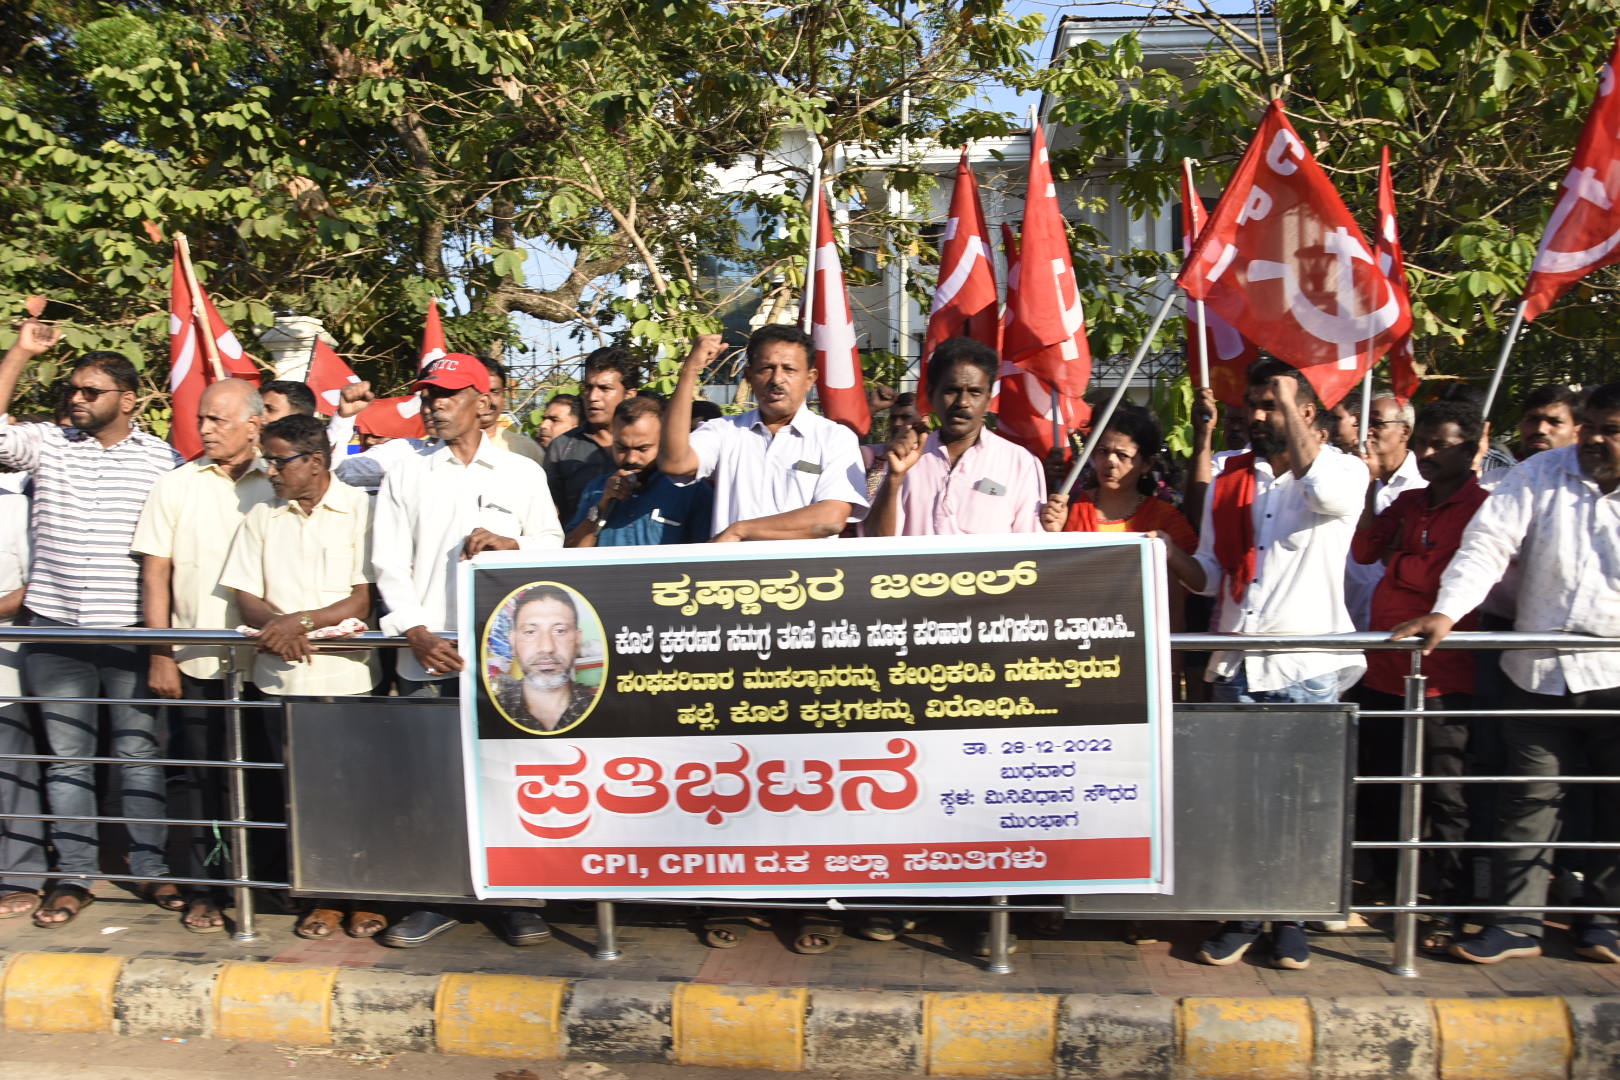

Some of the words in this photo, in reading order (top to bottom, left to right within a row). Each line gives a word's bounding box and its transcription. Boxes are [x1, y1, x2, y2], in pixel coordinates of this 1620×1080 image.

[652, 569, 845, 616] ಕೃಷ್ಣಾಪುರ
[870, 561, 1038, 599] ಜಲೀಲ್
[730, 700, 788, 723] ಕೊಲೆ
[1001, 739, 1112, 754] 28-12-2022
[1001, 761, 1075, 781] ಬುಧವಾರ
[516, 739, 918, 839] ಪ್ರತಿಭಟನೆ
[984, 787, 1074, 806] ಮಿನಿವಿಧಾನ
[1084, 784, 1138, 803] ಸೌಧದ
[1000, 812, 1079, 830] ಮುಂಭಾಗ
[581, 854, 649, 878] CPI,
[659, 854, 746, 874] CPIM
[824, 855, 890, 879] ಜಿಲ್ಲಾ
[903, 847, 1047, 871] ಸಮಿತಿಗಳು
